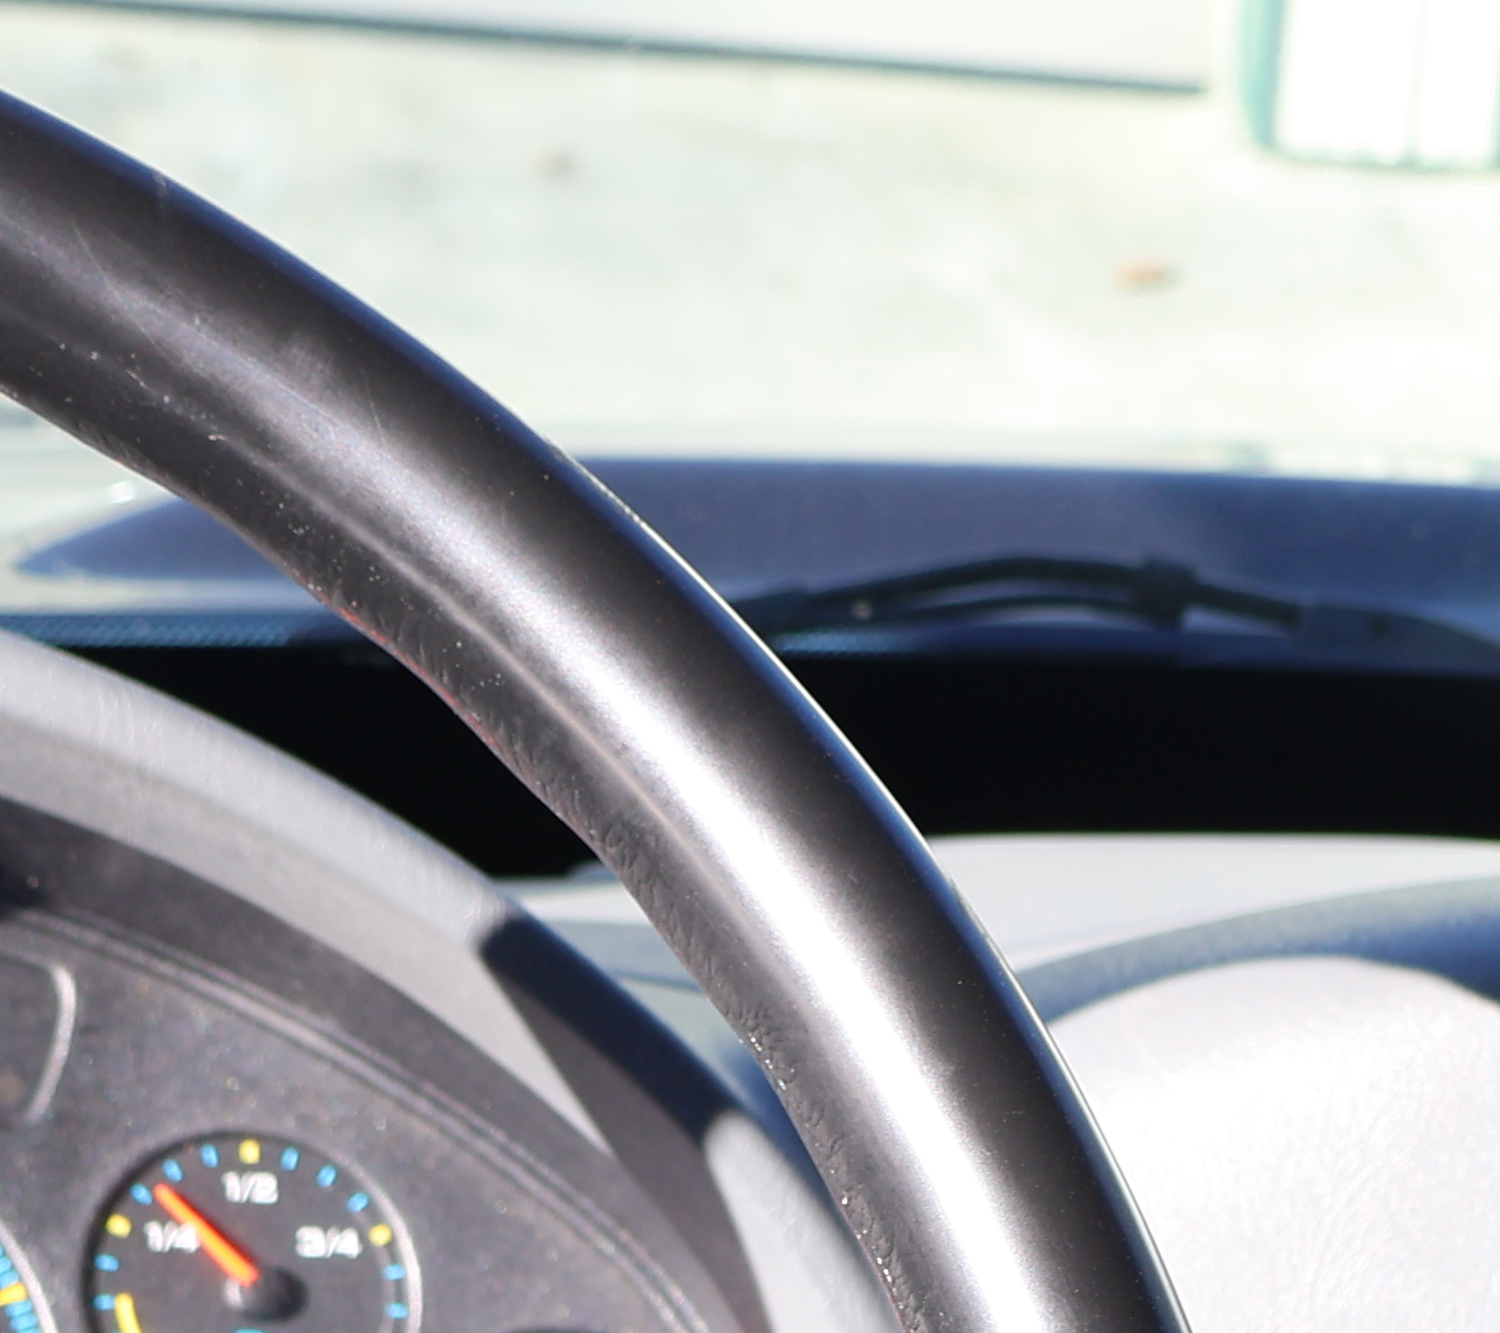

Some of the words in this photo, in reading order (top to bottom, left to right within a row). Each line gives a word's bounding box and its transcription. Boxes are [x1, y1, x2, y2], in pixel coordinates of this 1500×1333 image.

[221, 1171, 278, 1204] 1/2
[144, 1221, 200, 1253] 1/4
[295, 1226, 363, 1258] 3/4
